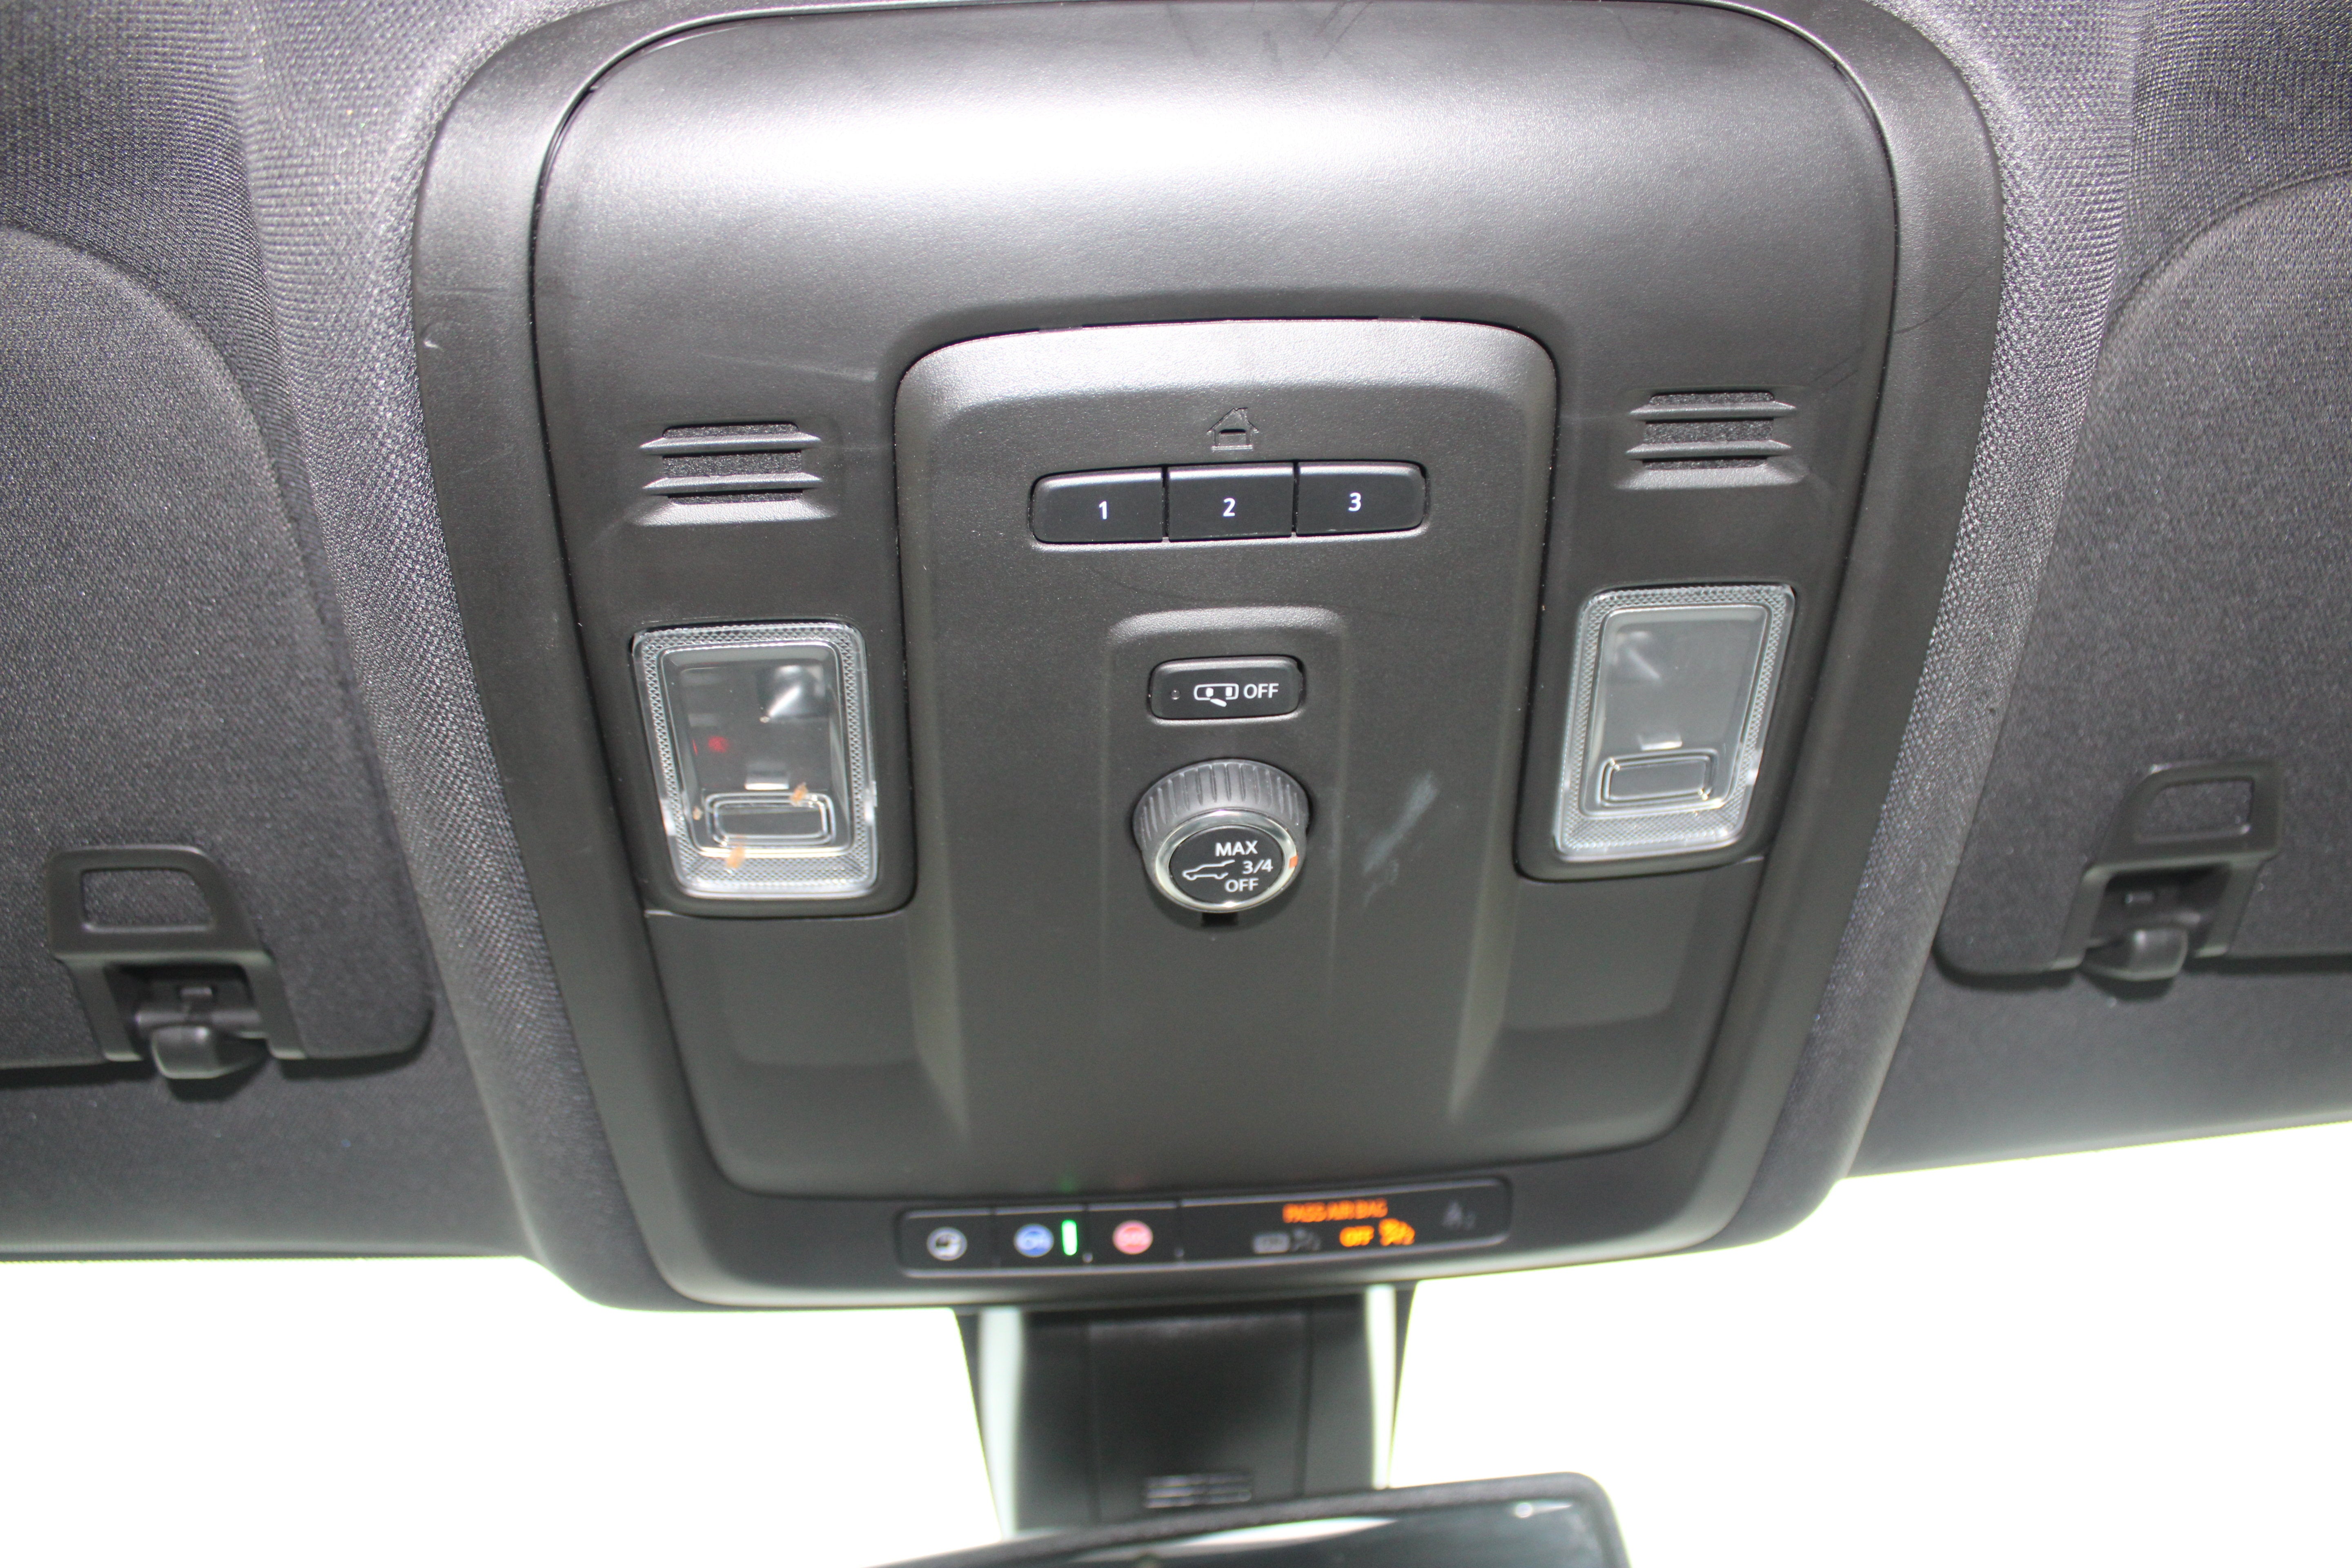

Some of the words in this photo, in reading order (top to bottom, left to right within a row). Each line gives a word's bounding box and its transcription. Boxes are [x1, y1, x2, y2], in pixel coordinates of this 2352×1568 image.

[1098, 501, 1107, 520] 1
[1223, 497, 1236, 517] 2
[1348, 492, 1361, 512] 3
[1243, 683, 1279, 699] OFF
[1214, 840, 1258, 858] MAX
[1242, 859, 1274, 874] 3/4
[1225, 878, 1259, 893] OFF
